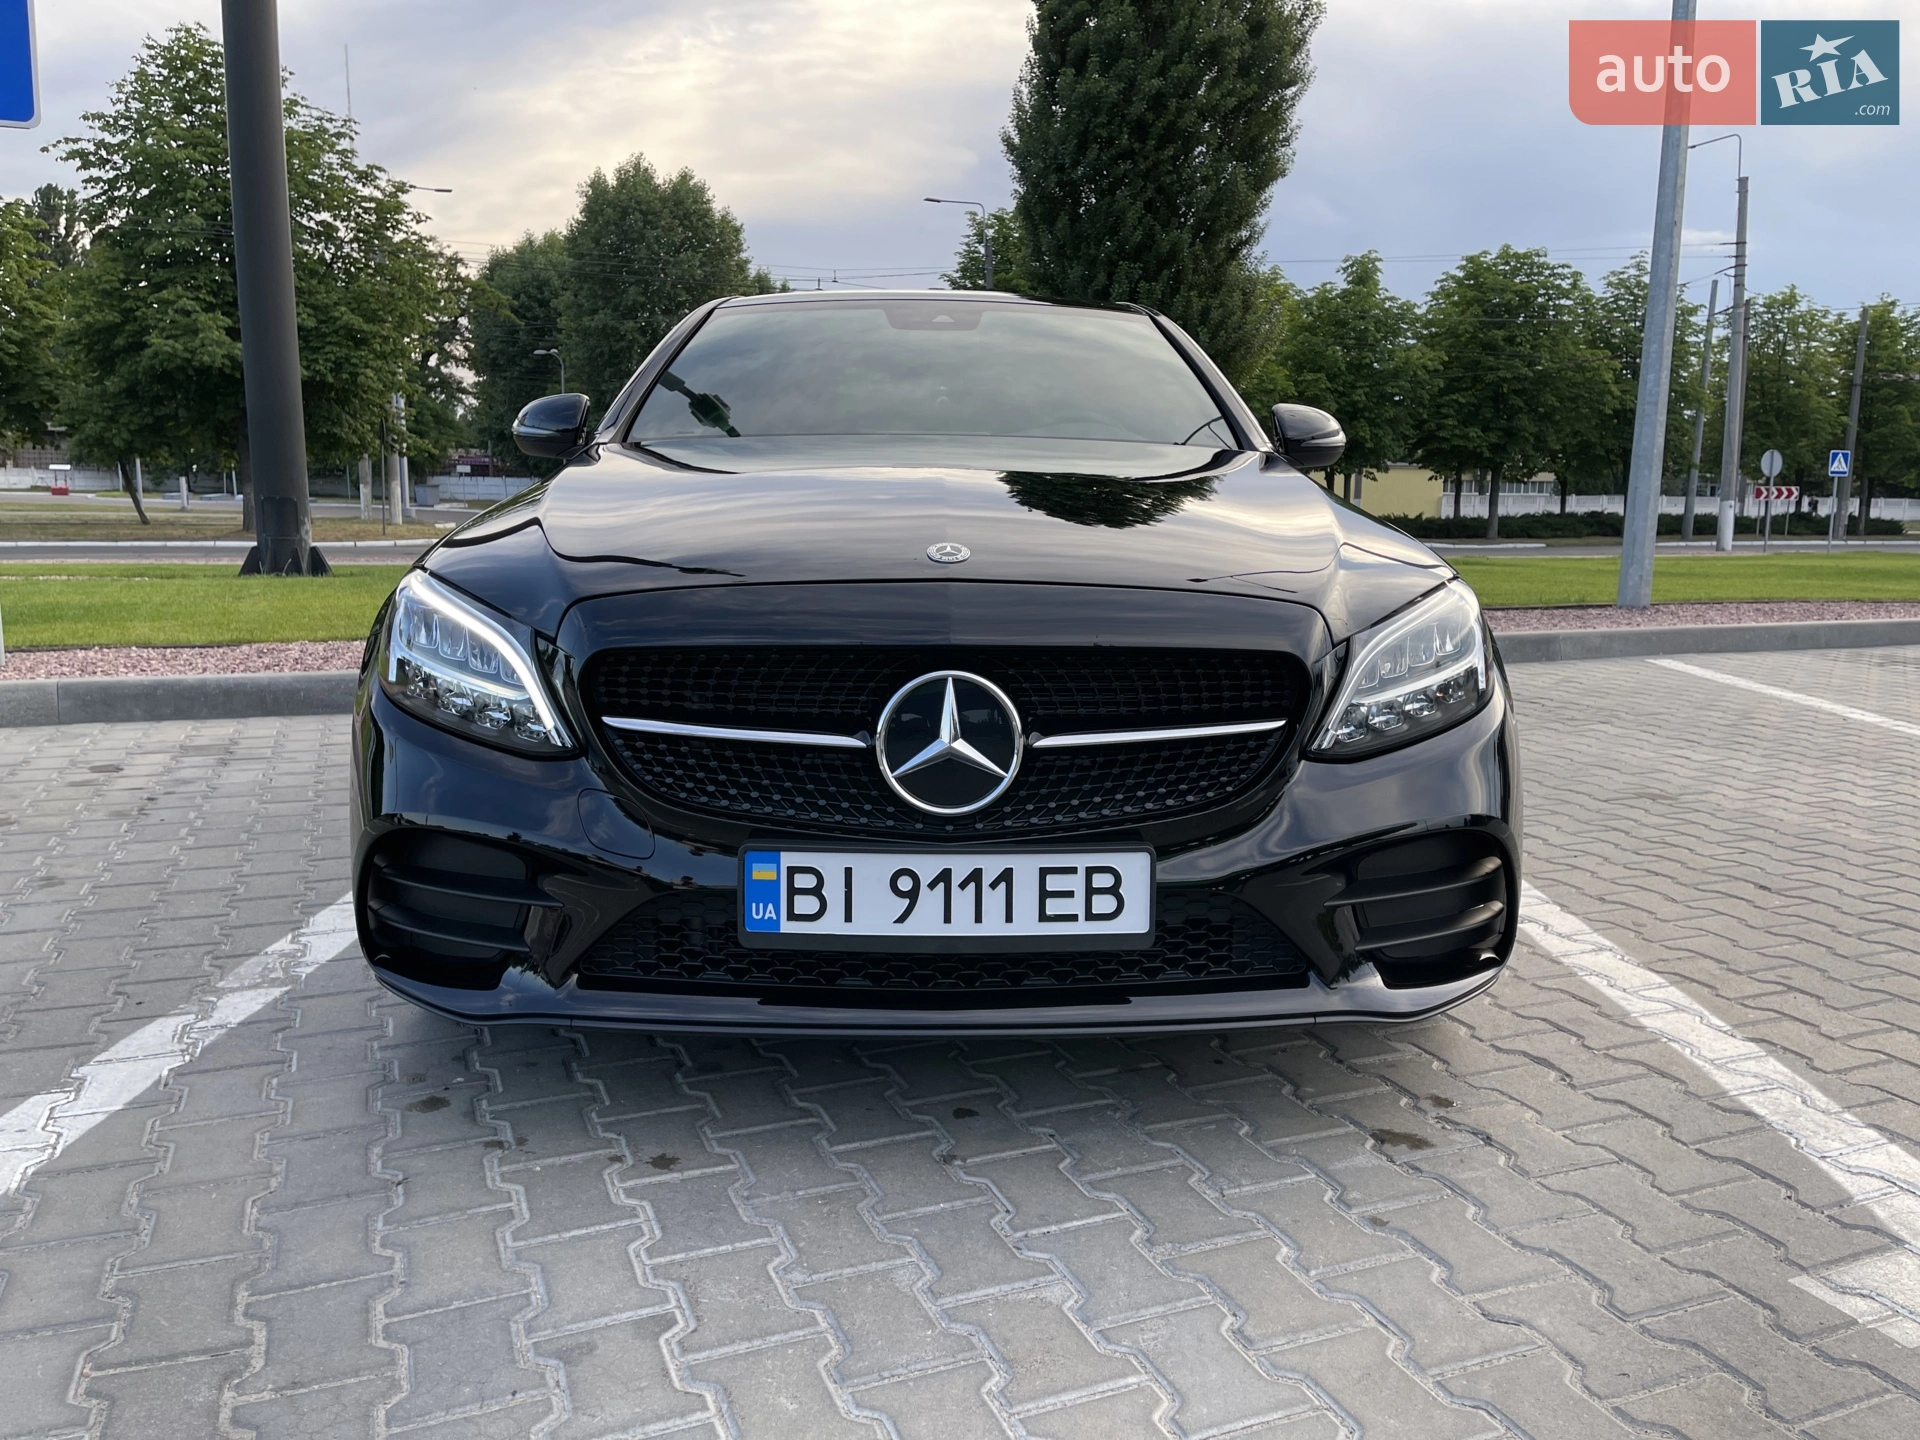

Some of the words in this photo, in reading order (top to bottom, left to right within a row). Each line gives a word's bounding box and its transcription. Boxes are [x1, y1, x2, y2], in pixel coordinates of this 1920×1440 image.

[752, 903, 777, 920] UA
[786, 865, 853, 923] BI
[889, 867, 1014, 924] 9111
[1038, 865, 1125, 923] EB
